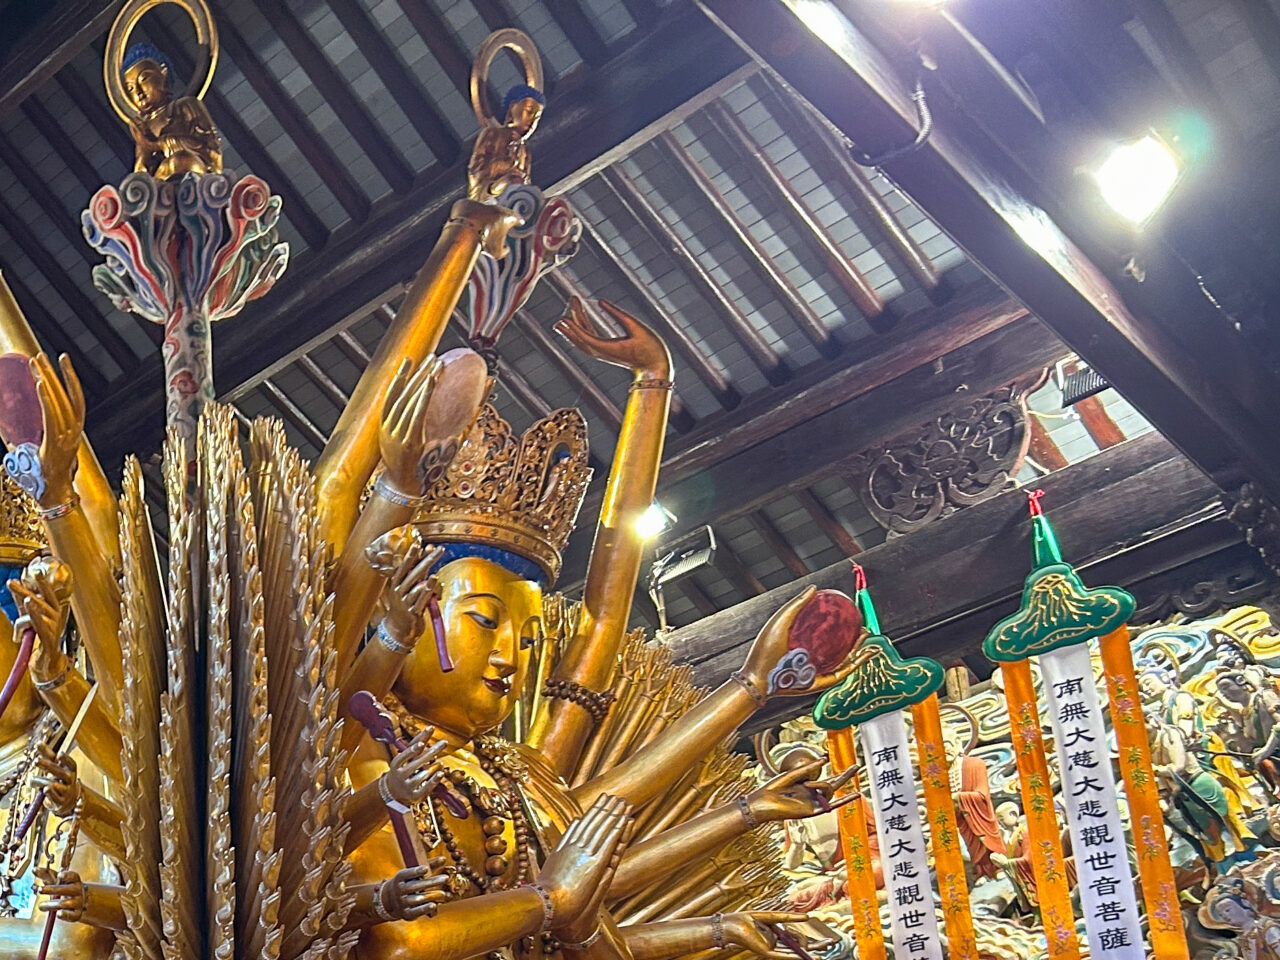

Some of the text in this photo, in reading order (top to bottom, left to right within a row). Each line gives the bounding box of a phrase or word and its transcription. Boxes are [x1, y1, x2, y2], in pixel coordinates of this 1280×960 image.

[1052, 675, 1133, 952] 南無大慈大悲觀世音菩薩
